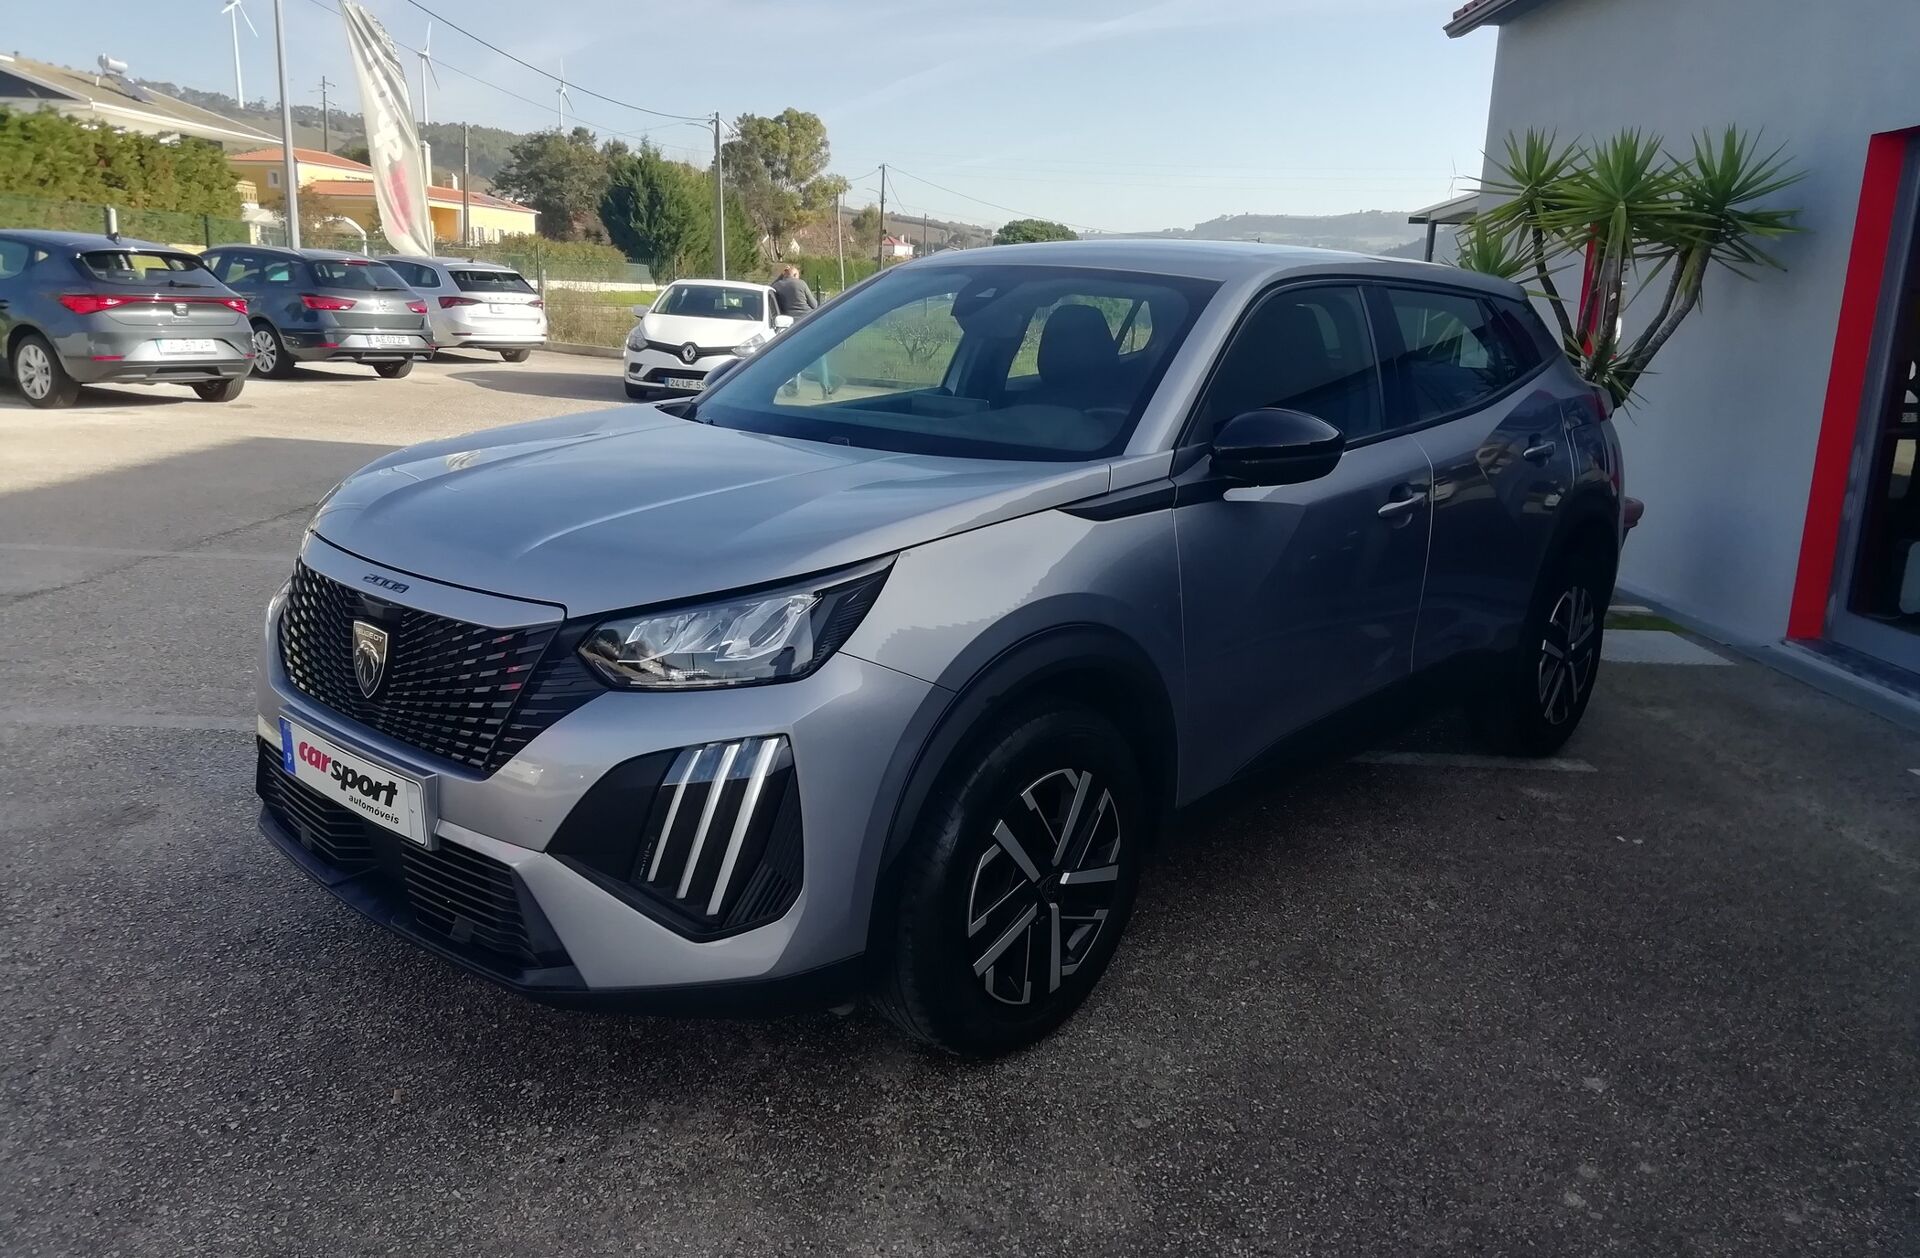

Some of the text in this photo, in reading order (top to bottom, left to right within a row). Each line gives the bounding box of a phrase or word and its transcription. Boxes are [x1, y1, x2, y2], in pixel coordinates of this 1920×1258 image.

[670, 378, 680, 387] 24
[362, 573, 410, 594] 2008
[348, 794, 400, 825] automóveis
